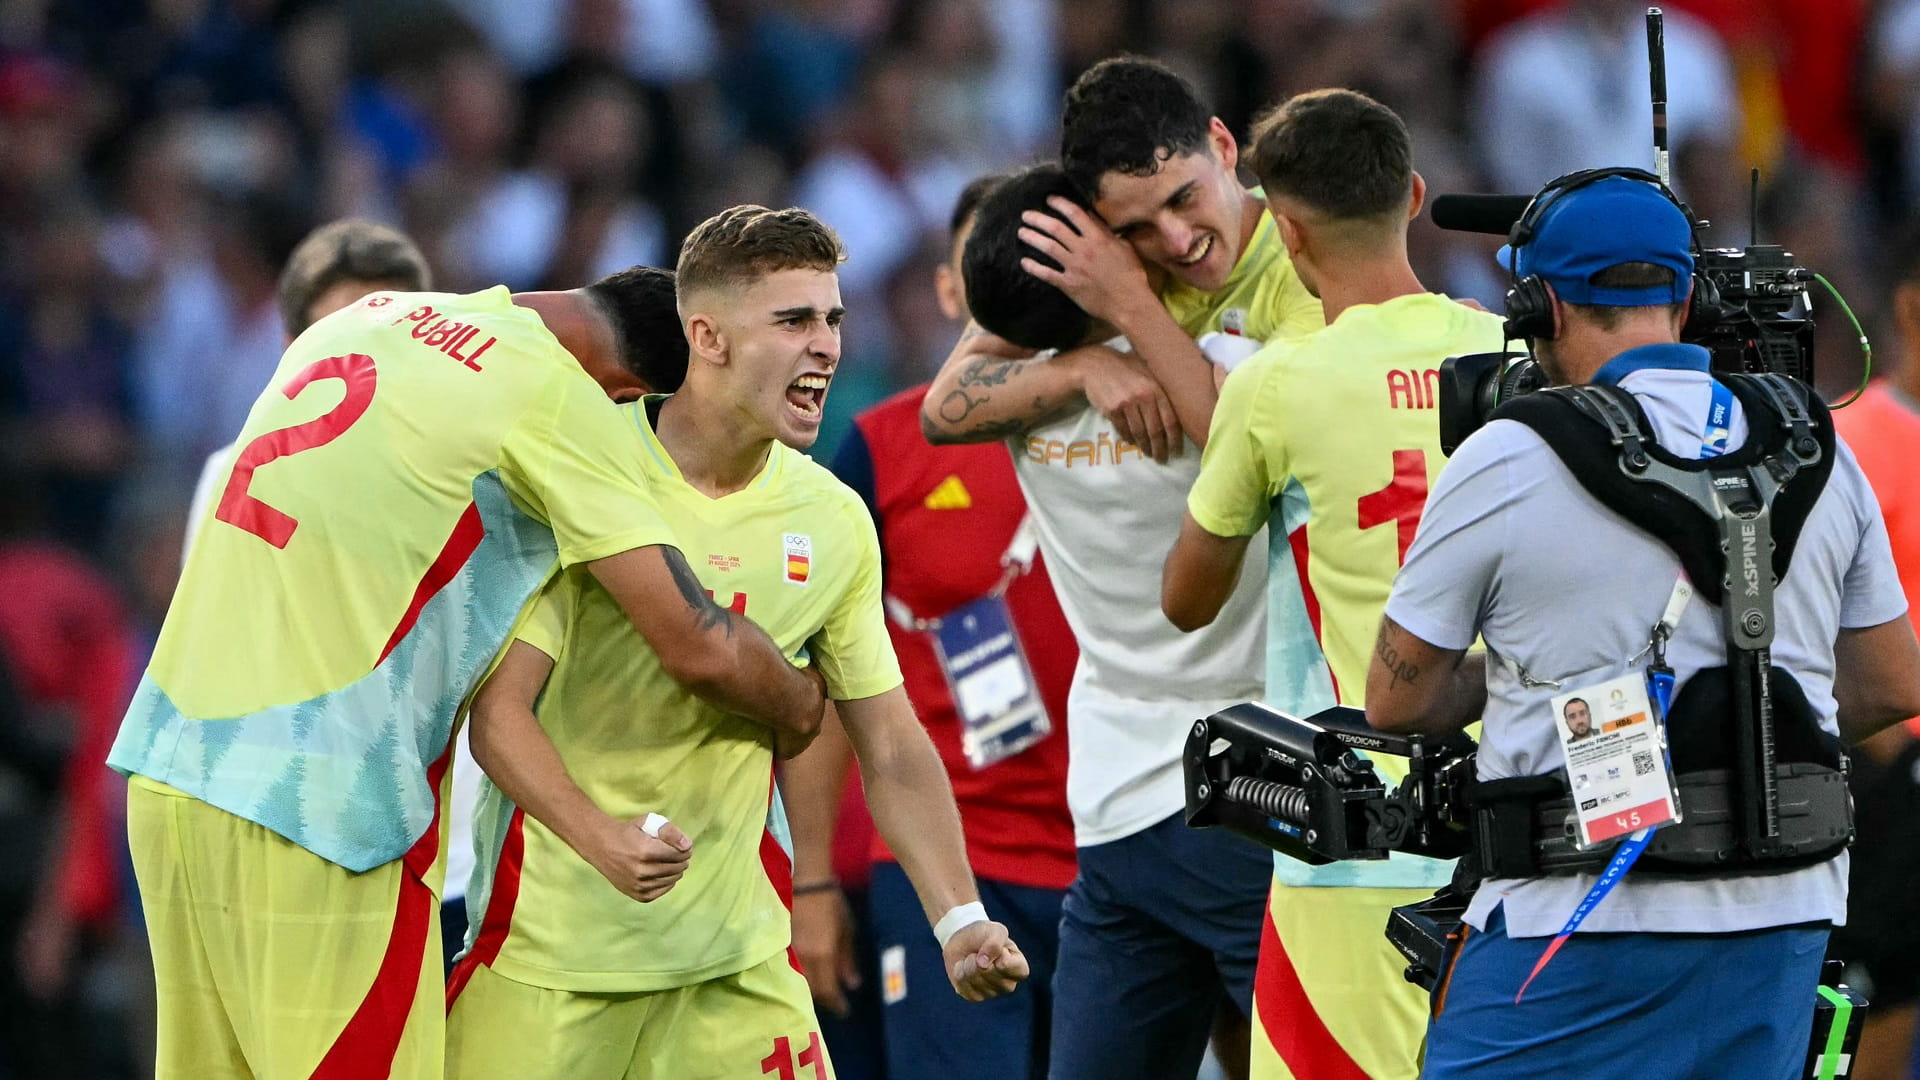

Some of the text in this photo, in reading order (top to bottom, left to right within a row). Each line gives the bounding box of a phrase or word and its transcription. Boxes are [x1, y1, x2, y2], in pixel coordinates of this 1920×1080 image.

[391, 306, 497, 373] PUBILL
[215, 353, 377, 550] 2
[1566, 890, 1600, 931] PARIS
[761, 1032, 828, 1080] 11
